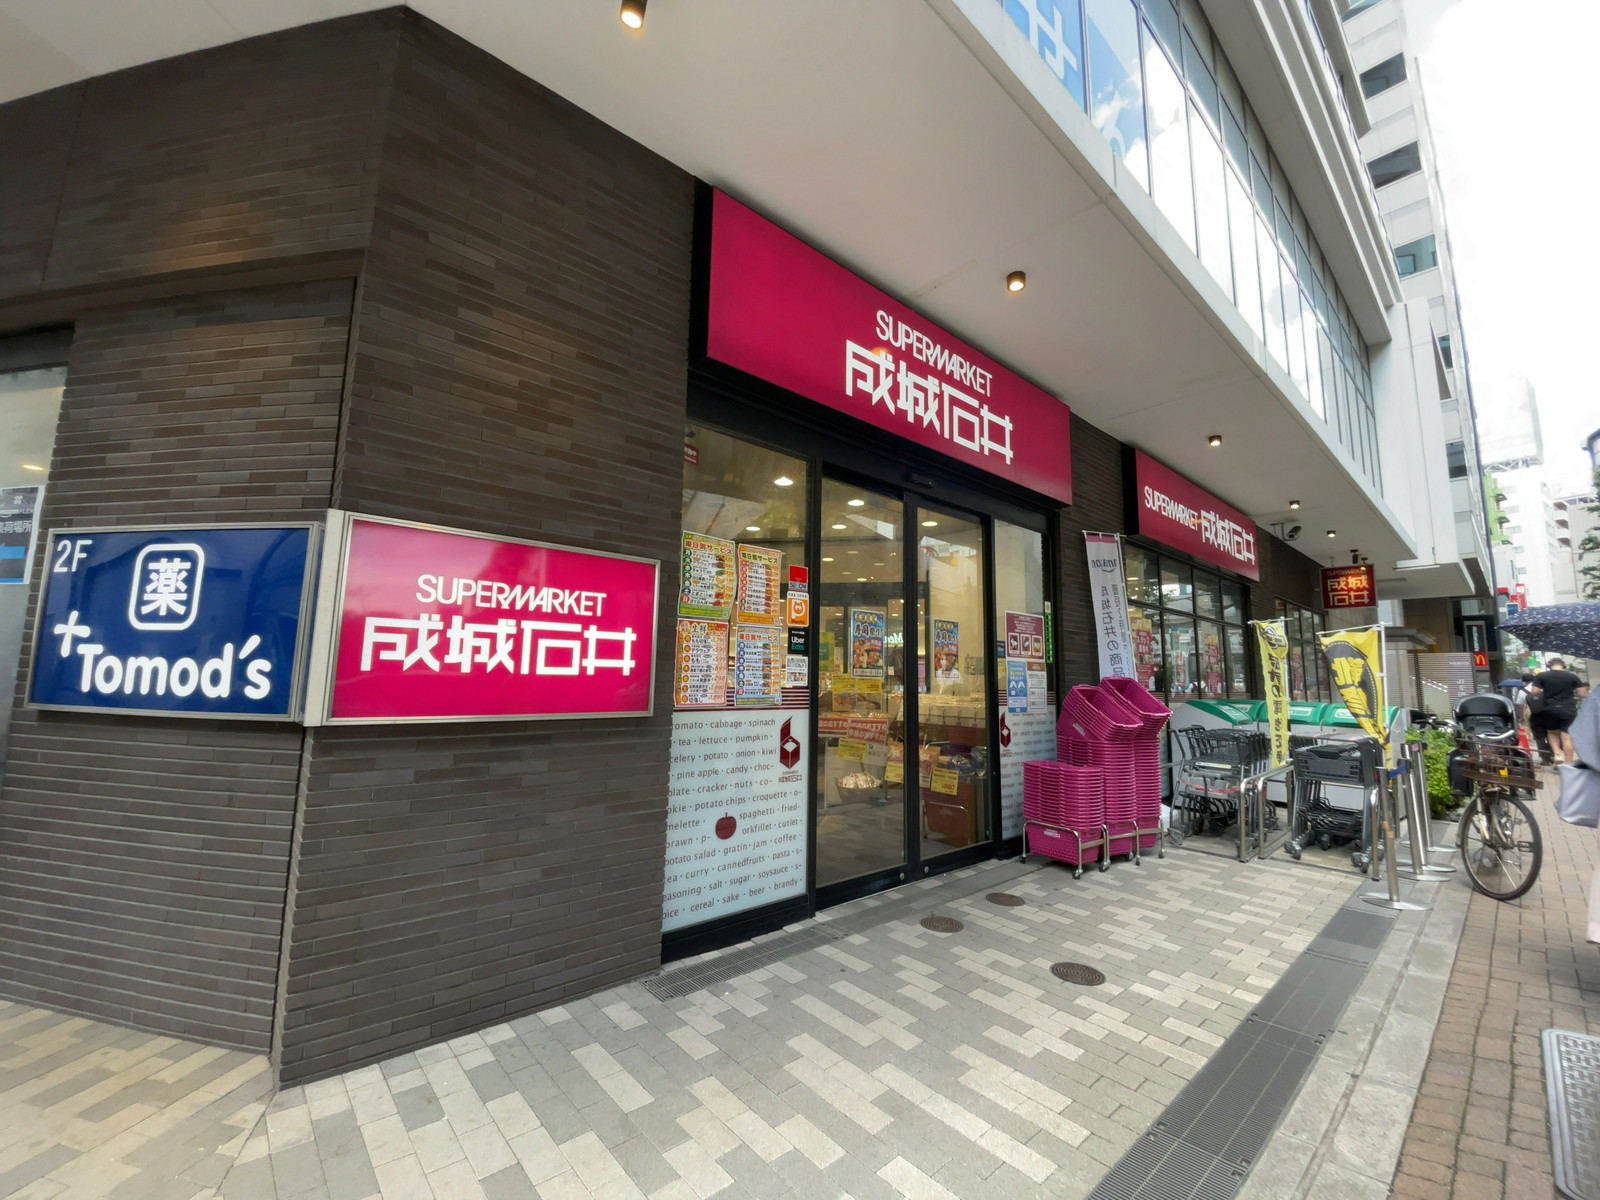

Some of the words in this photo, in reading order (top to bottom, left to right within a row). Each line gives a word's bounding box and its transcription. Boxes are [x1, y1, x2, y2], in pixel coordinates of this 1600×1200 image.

[875, 309, 993, 397] SUPERMARKET
[845, 339, 1014, 466] 成城石井
[1143, 484, 1199, 530] SUPERMARKET
[1200, 508, 1256, 566] 成城石井
[53, 539, 93, 573] 2F
[141, 557, 188, 616] 薬
[415, 573, 607, 618] SUPERMARKET
[1328, 574, 1369, 591] 成城
[1329, 590, 1370, 607] 石井
[360, 613, 637, 677] 成城石井
[791, 636, 804, 644] Uber
[77, 635, 272, 701] Tomod's
[710, 720, 742, 730] cabbage
[748, 718, 776, 727] spinach
[699, 736, 728, 744] lettuce
[735, 734, 768, 744] pumpkin
[703, 752, 728, 762] potato
[736, 750, 756, 758] onion
[676, 770, 695, 780] pine
[698, 768, 720, 778] apple
[726, 765, 748, 775] candy
[695, 801, 724, 812] potato
[726, 796, 746, 807] chips
[752, 791, 788, 803] croquette
[697, 783, 728, 794] cracker
[739, 808, 774, 820] spaghetti
[742, 824, 772, 836] orkfillet
[778, 818, 798, 828] cutlet
[694, 848, 716, 861] salad
[724, 844, 748, 856] gratin
[752, 840, 768, 850] jam
[774, 834, 797, 844] coffee
[686, 867, 710, 880] curry
[717, 856, 766, 872] cannedfruits
[772, 850, 790, 861] pasta
[708, 880, 723, 891] salt
[730, 875, 751, 887] sugar
[758, 865, 789, 879] soysauce
[690, 898, 715, 912] cereal
[722, 892, 740, 904] sake
[748, 886, 766, 897] beer
[774, 879, 798, 891] brandy
